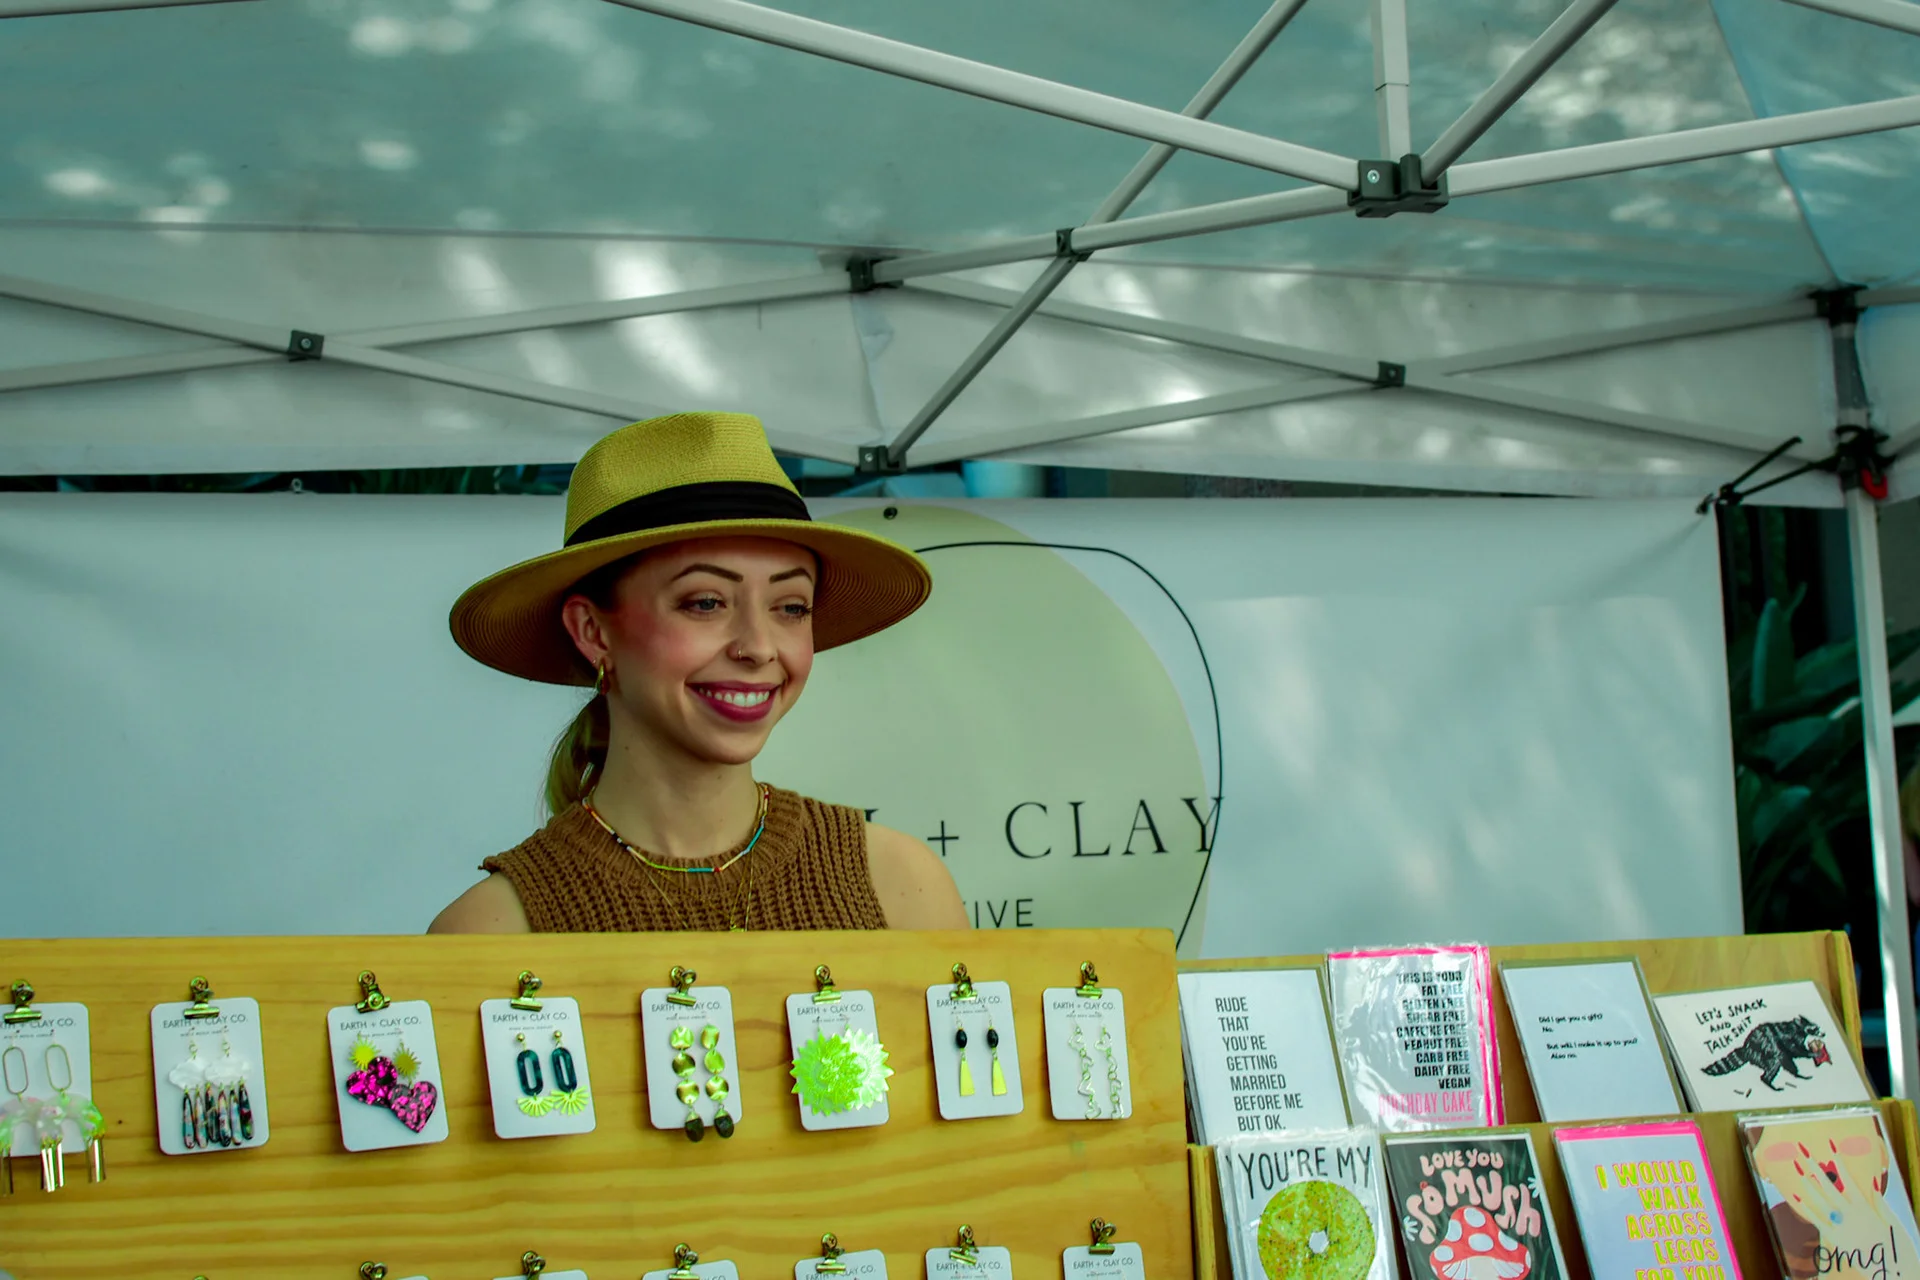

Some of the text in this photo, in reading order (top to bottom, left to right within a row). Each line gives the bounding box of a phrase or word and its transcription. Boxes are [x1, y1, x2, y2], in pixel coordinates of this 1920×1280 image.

[1004, 797, 1224, 858] CLAY
[1396, 970, 1462, 984] THIS IS YOUR
[1422, 984, 1464, 996] FAT FREE
[1215, 996, 1248, 1012] RUDE
[1442, 998, 1464, 1008] FREE
[1696, 998, 1767, 1025] LET'S SNACK
[1218, 1016, 1249, 1032] THAT
[1406, 1010, 1466, 1024] SUGAR FREE
[1444, 1024, 1466, 1035] FREE
[1704, 1016, 1752, 1054] TALK SHIT
[1710, 1022, 1731, 1033] AND
[1222, 1035, 1267, 1052] YOU'RE
[1404, 1037, 1468, 1050] PEANUT FREE
[1226, 1054, 1278, 1072] GETTING
[1416, 1050, 1469, 1064] CARB FREE
[1414, 1064, 1470, 1077] DAIRY FREE
[1230, 1074, 1286, 1091] MARRIED
[1438, 1077, 1471, 1089] VEGAN
[1234, 1092, 1304, 1112] BEFORE ME
[1442, 1090, 1472, 1113] CAKE
[1238, 1114, 1286, 1132] BUT OK.
[1419, 1148, 1504, 1176] LOVE YOU
[1238, 1146, 1370, 1200] YOU'RE MY
[1595, 1160, 1696, 1190] I WOULD
[1638, 1185, 1705, 1212] WALK
[1406, 1186, 1444, 1244] SO
[1626, 1212, 1712, 1240] ACROSS
[1653, 1238, 1720, 1265] LEGOS
[1813, 1225, 1900, 1280] omg!
[1682, 1265, 1726, 1280] YOU
